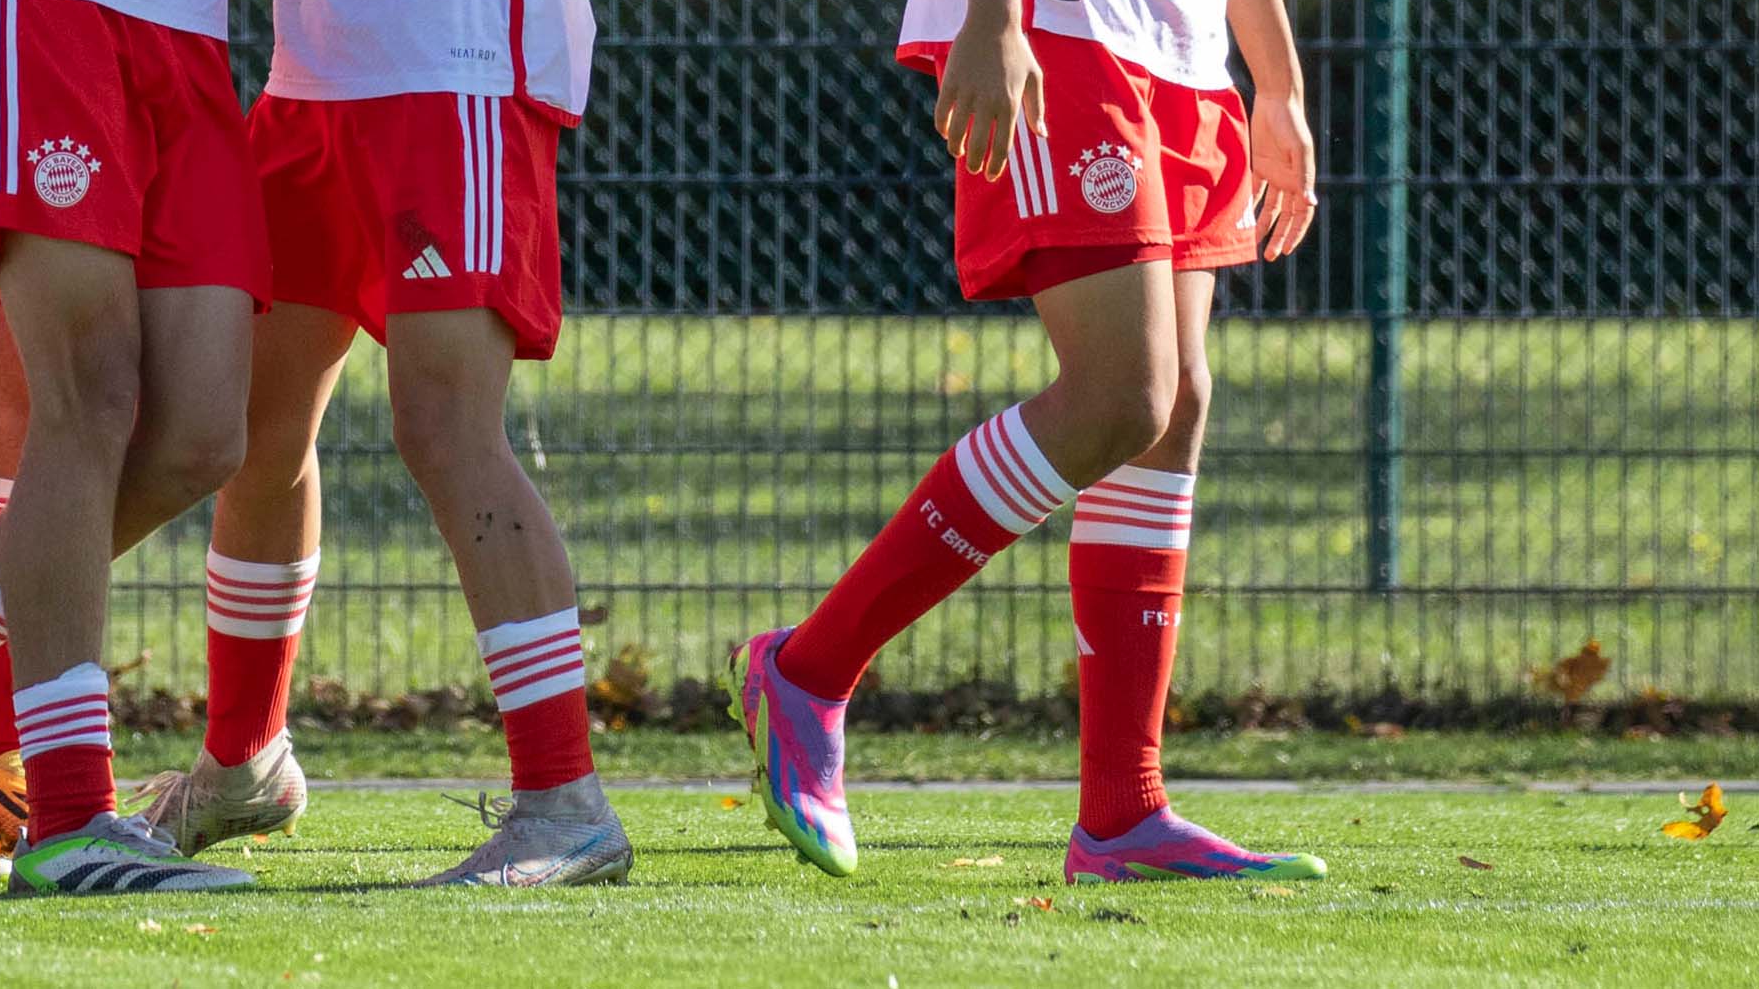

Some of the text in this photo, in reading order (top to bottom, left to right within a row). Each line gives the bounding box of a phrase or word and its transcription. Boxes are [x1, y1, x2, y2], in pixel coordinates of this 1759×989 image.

[52, 156, 85, 178] BAYERN
[1096, 161, 1130, 180] BAYERN
[920, 499, 989, 567] FC BAYE
[1143, 610, 1170, 627] FC
